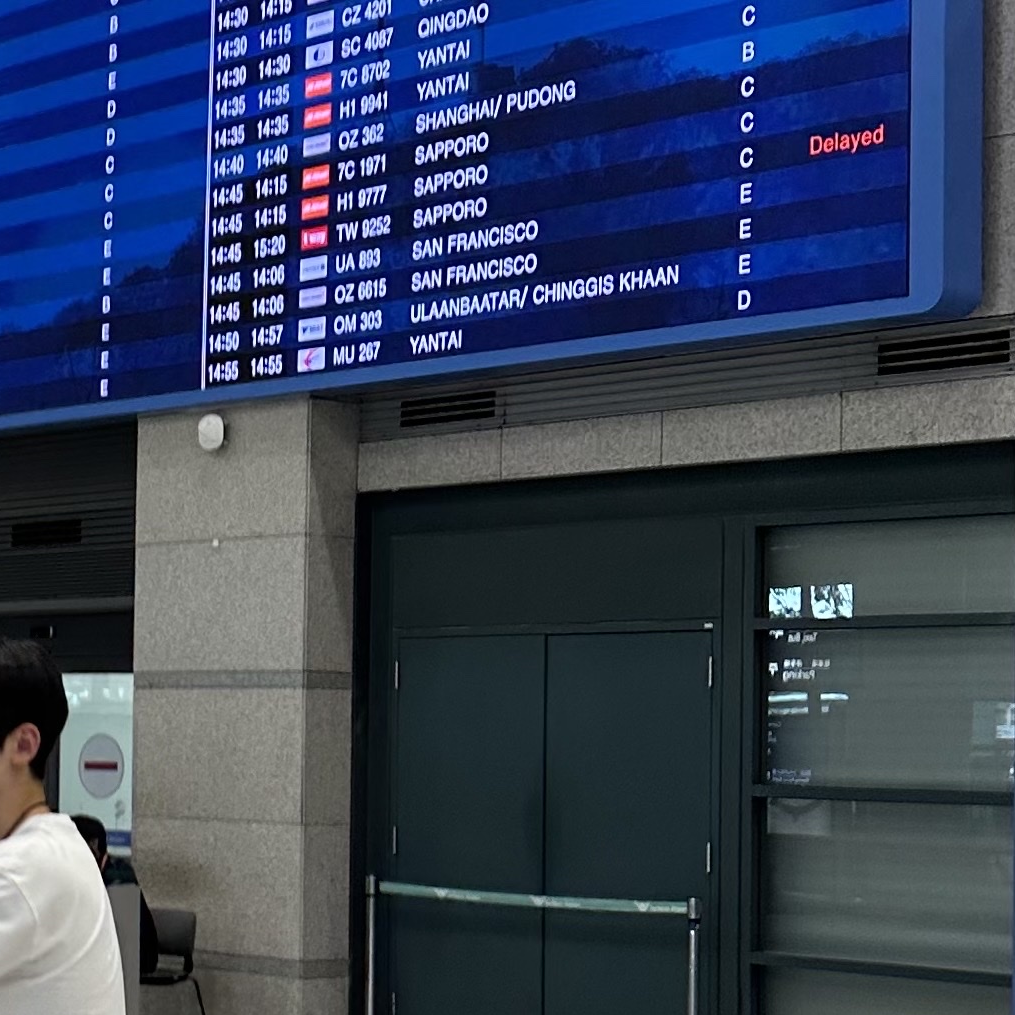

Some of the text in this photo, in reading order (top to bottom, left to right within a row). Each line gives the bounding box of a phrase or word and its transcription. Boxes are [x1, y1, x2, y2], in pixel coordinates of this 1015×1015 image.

[216, 65, 246, 90] 14:30
[259, 53, 290, 79] 14:30
[341, 35, 360, 58] SC
[418, 3, 488, 38] QINGDAO
[217, 35, 247, 61] 14:30
[260, 23, 291, 49] 14:15
[342, 4, 361, 27] CZ
[218, 6, 248, 31] 14:30
[107, 99, 116, 118] D
[213, 154, 244, 178] 14:40
[256, 144, 288, 169] 14:40
[338, 128, 359, 150] OZ
[416, 94, 502, 133] SHANGHAI/
[506, 80, 575, 113] PUDONG
[742, 41, 754, 62] B
[214, 124, 244, 149] 14:35
[257, 114, 288, 139] 14:35
[339, 98, 355, 119] H1
[417, 71, 469, 100] YANTAI
[742, 5, 755, 26] C
[215, 94, 245, 119] 14:35
[258, 83, 289, 109] 14:35
[340, 67, 357, 88] 7C
[417, 39, 469, 69] YANTAI
[106, 128, 115, 146] D
[212, 213, 242, 237] 14:45
[255, 204, 286, 228] 14:15
[337, 191, 353, 212] H1
[414, 164, 488, 197] SAPPORO
[740, 111, 753, 132] C
[213, 183, 243, 207] 14:45
[255, 174, 287, 199] 14:15
[338, 160, 355, 181] 7C
[414, 132, 488, 165] SAPPORO
[740, 76, 754, 97] C
[210, 272, 241, 295] 14:45
[335, 252, 355, 273] UA
[412, 237, 442, 260] SAN
[447, 220, 538, 253] FRANCISCO
[740, 182, 752, 204] E
[211, 242, 241, 266] 14:45
[254, 234, 285, 258] 15:20
[336, 221, 358, 242] TW
[413, 197, 487, 228] SAPPORO
[740, 147, 753, 168] C
[810, 124, 883, 155] Delayed
[209, 331, 239, 353] 14:50
[252, 324, 283, 347] 14:57
[333, 314, 356, 335] OM
[410, 286, 528, 323] ULAANBAATAR/
[533, 274, 614, 304] CHINGGIS
[619, 265, 679, 292] KHAAN
[738, 253, 750, 274] E
[210, 301, 240, 324] 14:45
[334, 283, 354, 304] OZ
[411, 268, 442, 292] SAN
[446, 253, 537, 285] FRANCISCO
[739, 218, 751, 239] E
[208, 360, 238, 382] 14:55
[251, 354, 282, 377] 14:55
[333, 344, 355, 365] MU
[410, 329, 462, 354] YANTAI
[738, 289, 750, 310] D
